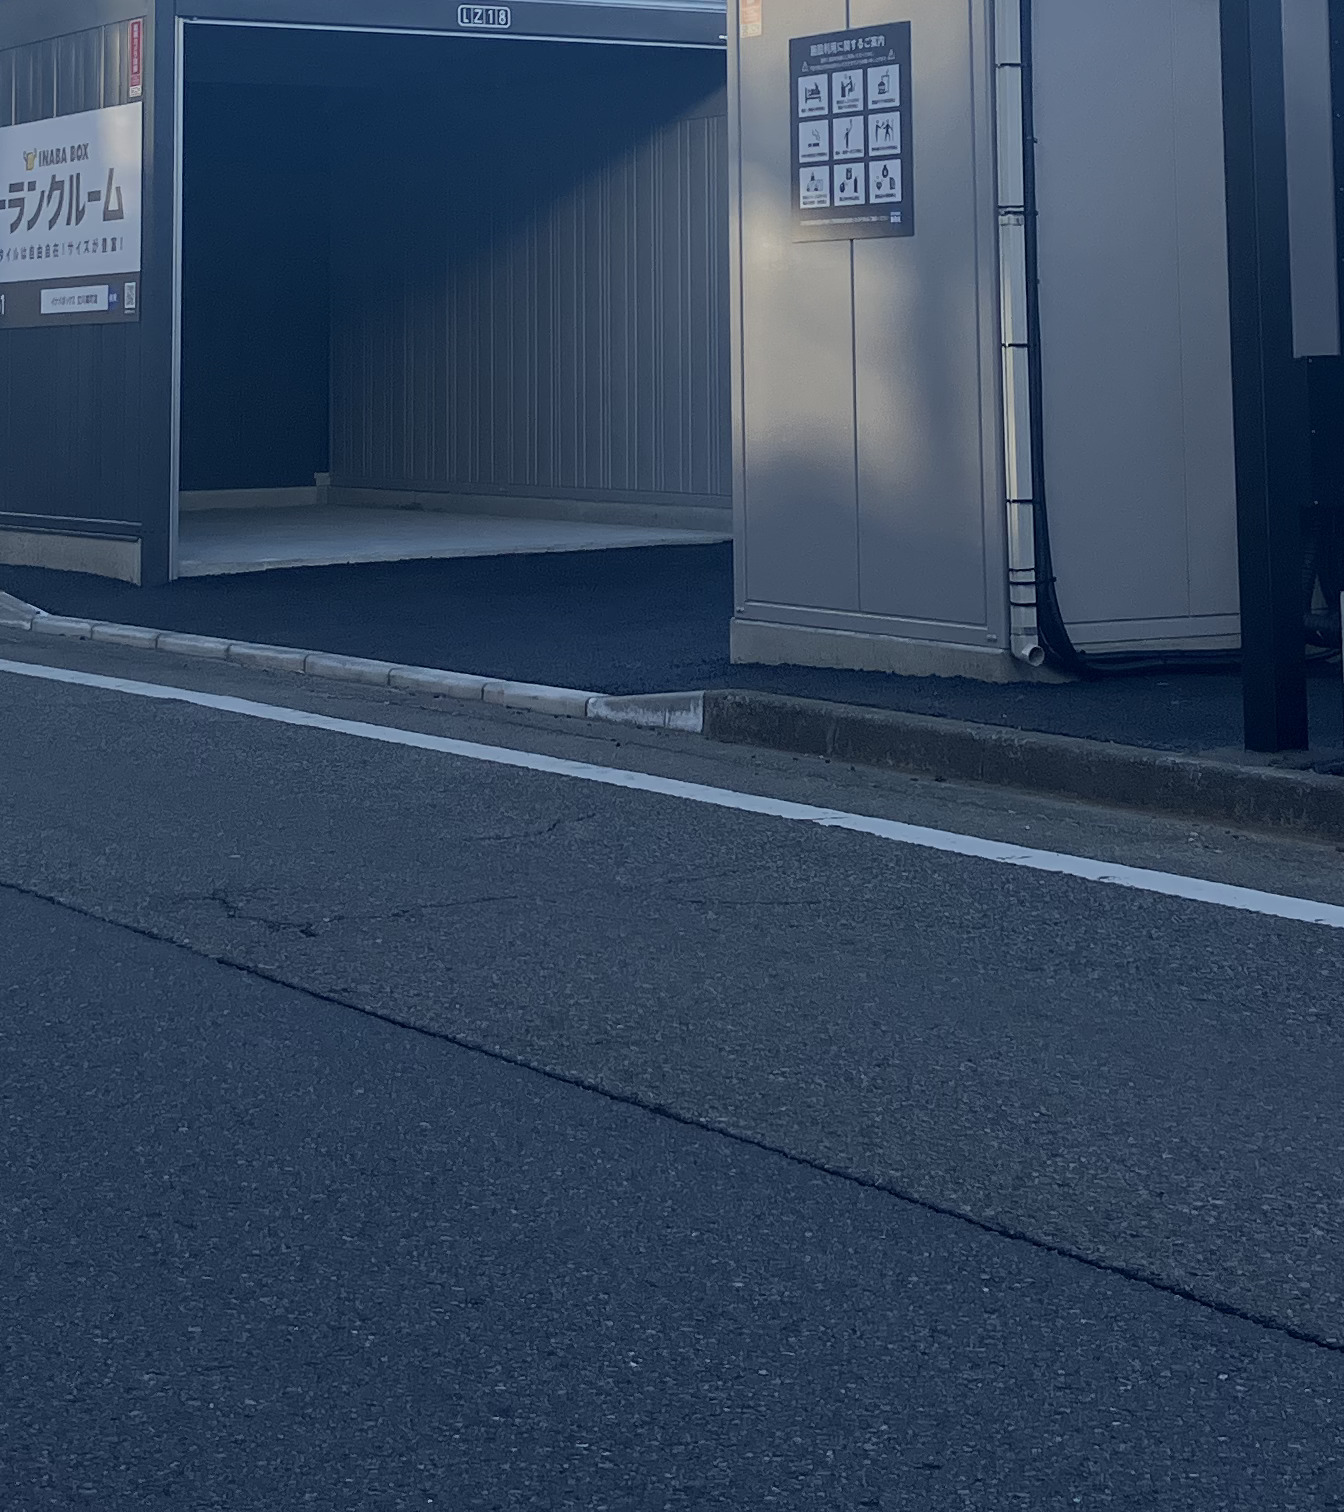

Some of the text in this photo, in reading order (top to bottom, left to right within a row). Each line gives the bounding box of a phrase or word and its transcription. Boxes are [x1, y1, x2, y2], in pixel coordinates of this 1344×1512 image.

[462, 8, 507, 25] LZ18
[39, 143, 90, 167] INABA BOX
